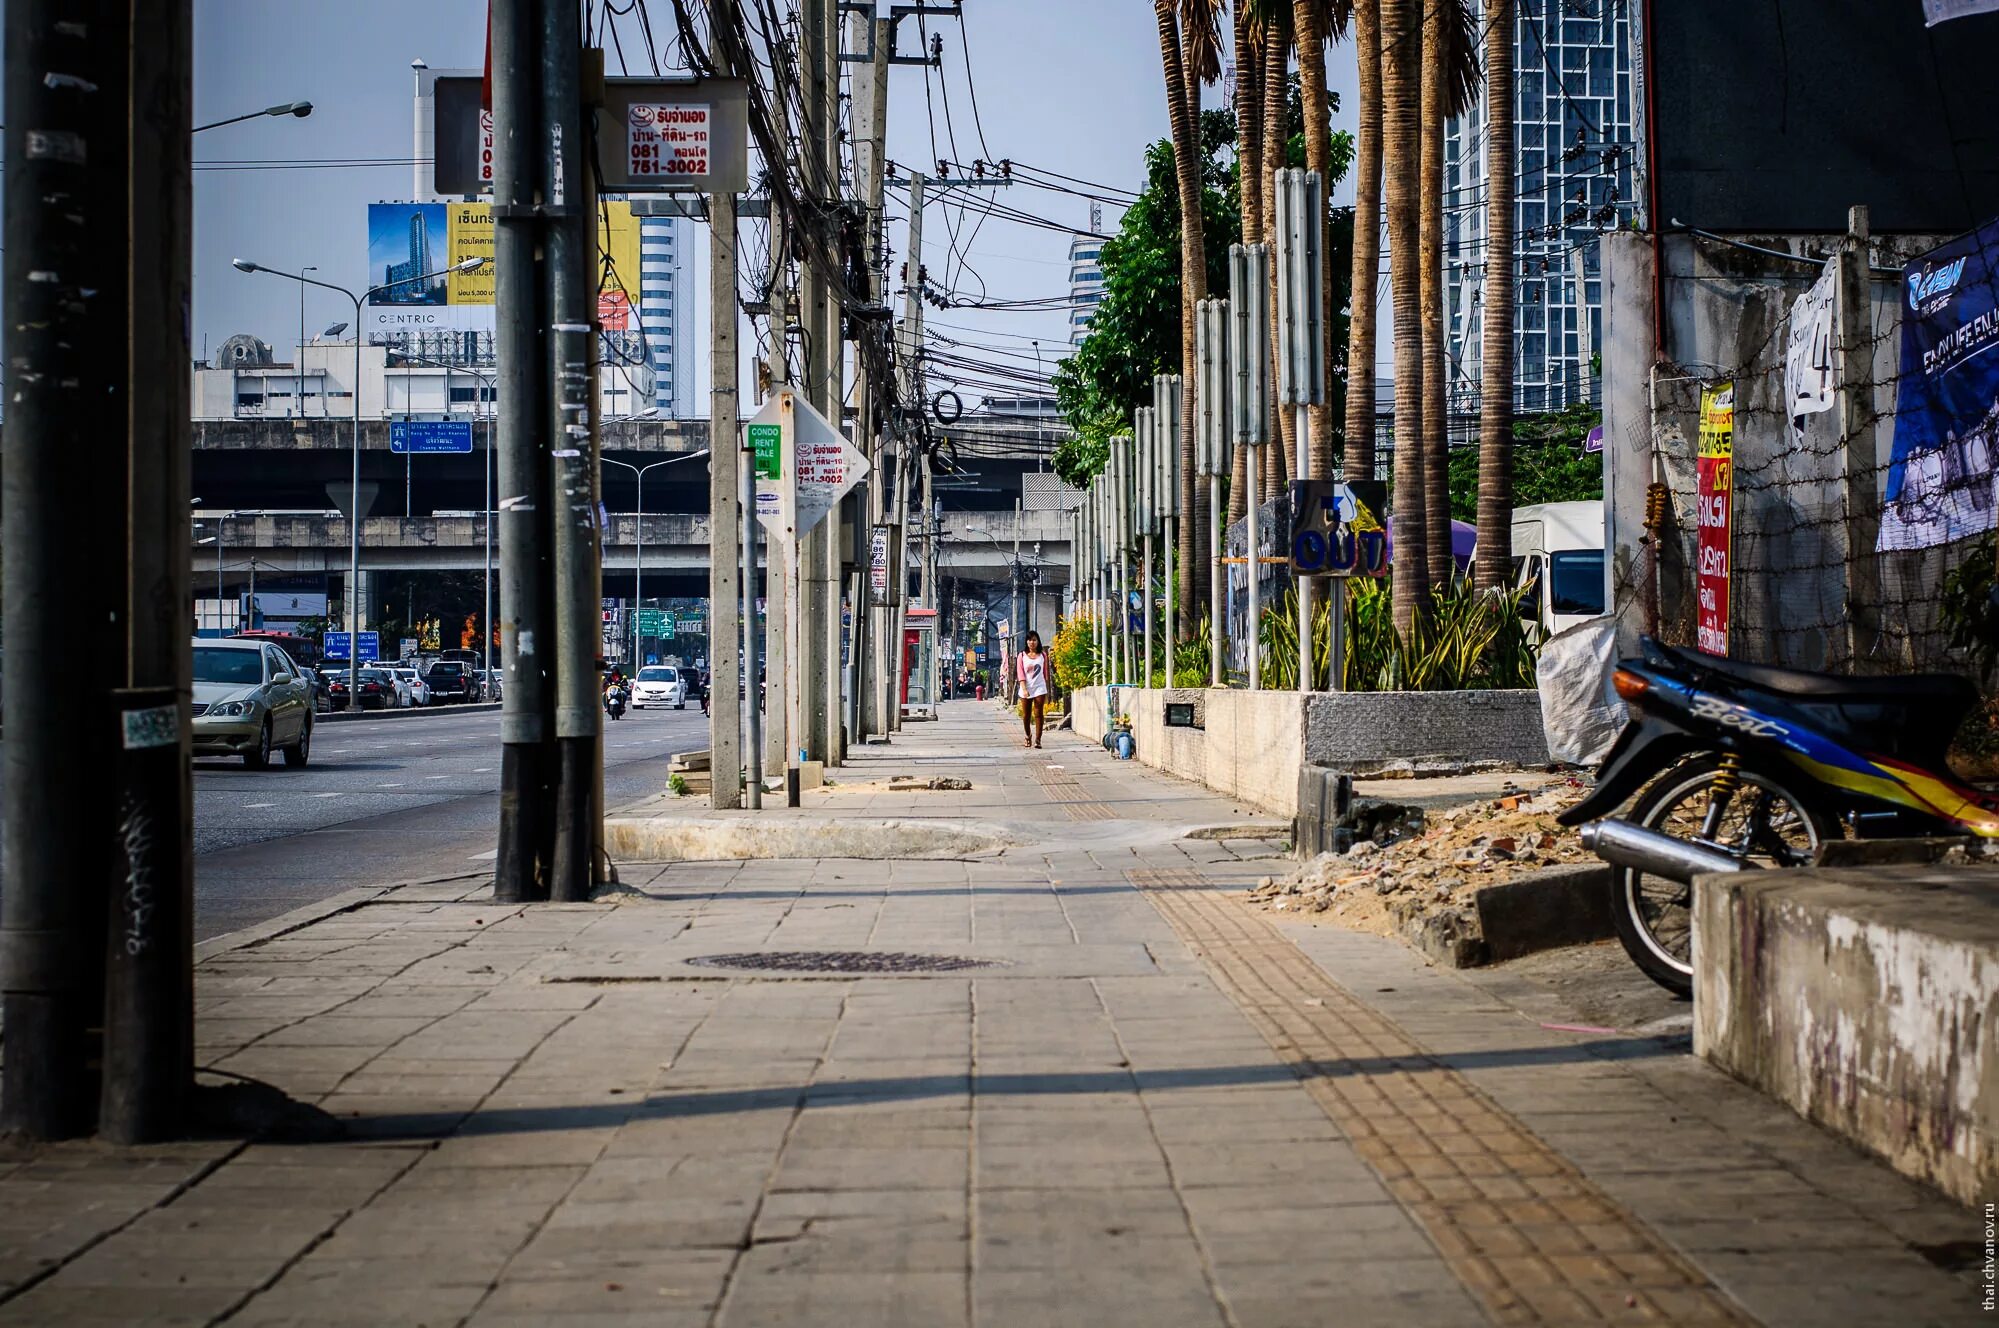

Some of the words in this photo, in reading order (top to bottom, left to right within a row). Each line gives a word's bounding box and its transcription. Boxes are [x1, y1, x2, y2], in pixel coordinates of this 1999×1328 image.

[657, 106, 706, 123] รับจำนอง
[631, 144, 659, 158] 081
[632, 159, 707, 174] 751-3002
[378, 314, 435, 323] CENTRIC
[751, 427, 779, 436] CONDO
[755, 439, 775, 447] RENT
[755, 449, 774, 458] SALE
[798, 467, 815, 475] 081
[1295, 530, 1384, 570] OUT
[1688, 694, 1790, 737] Best
